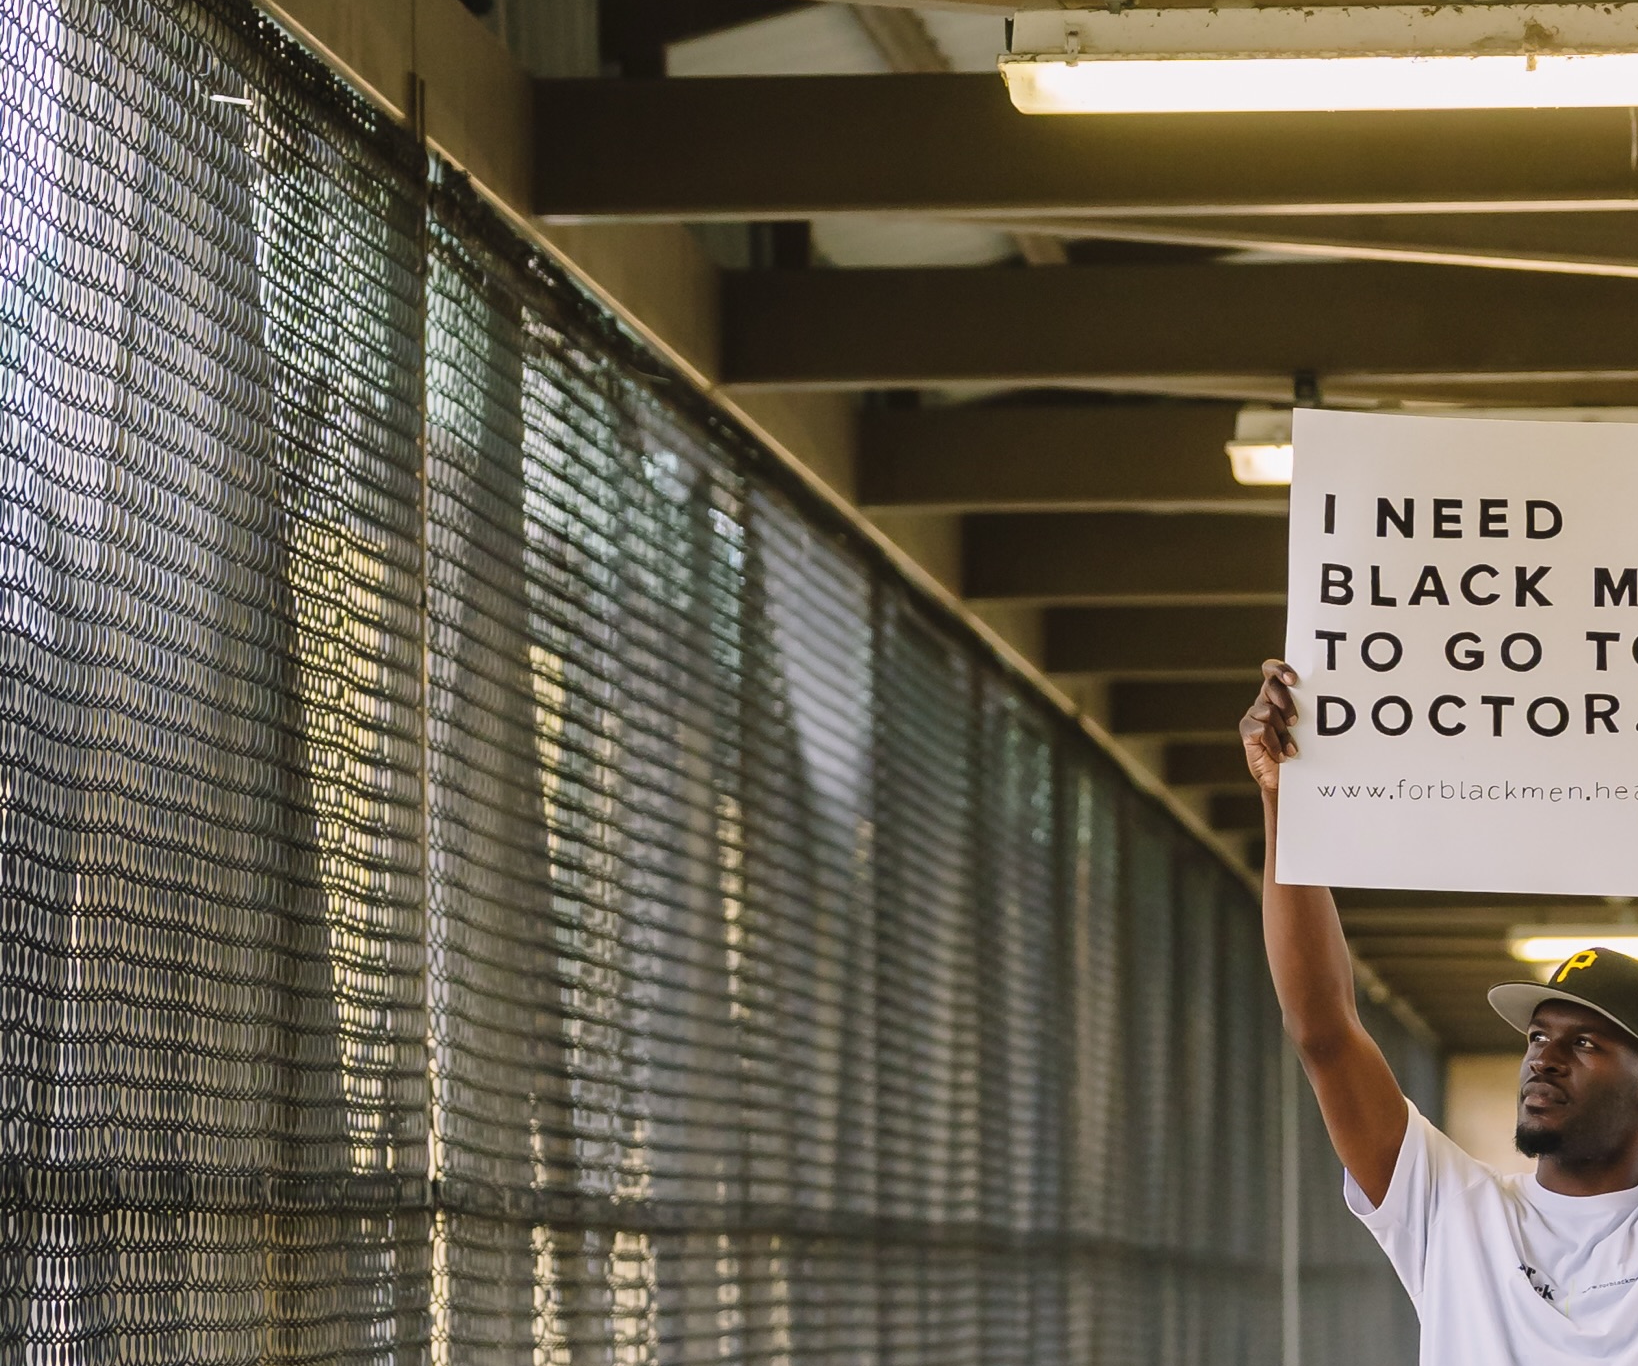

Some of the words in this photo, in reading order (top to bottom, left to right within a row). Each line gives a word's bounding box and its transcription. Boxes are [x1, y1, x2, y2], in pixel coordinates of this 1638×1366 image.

[1323, 493, 1337, 535] I
[1376, 497, 1563, 540] NEED
[1319, 562, 1554, 608] BLACK
[1314, 629, 1404, 673] TO
[1444, 631, 1543, 673] GO
[1556, 949, 1598, 983] P
